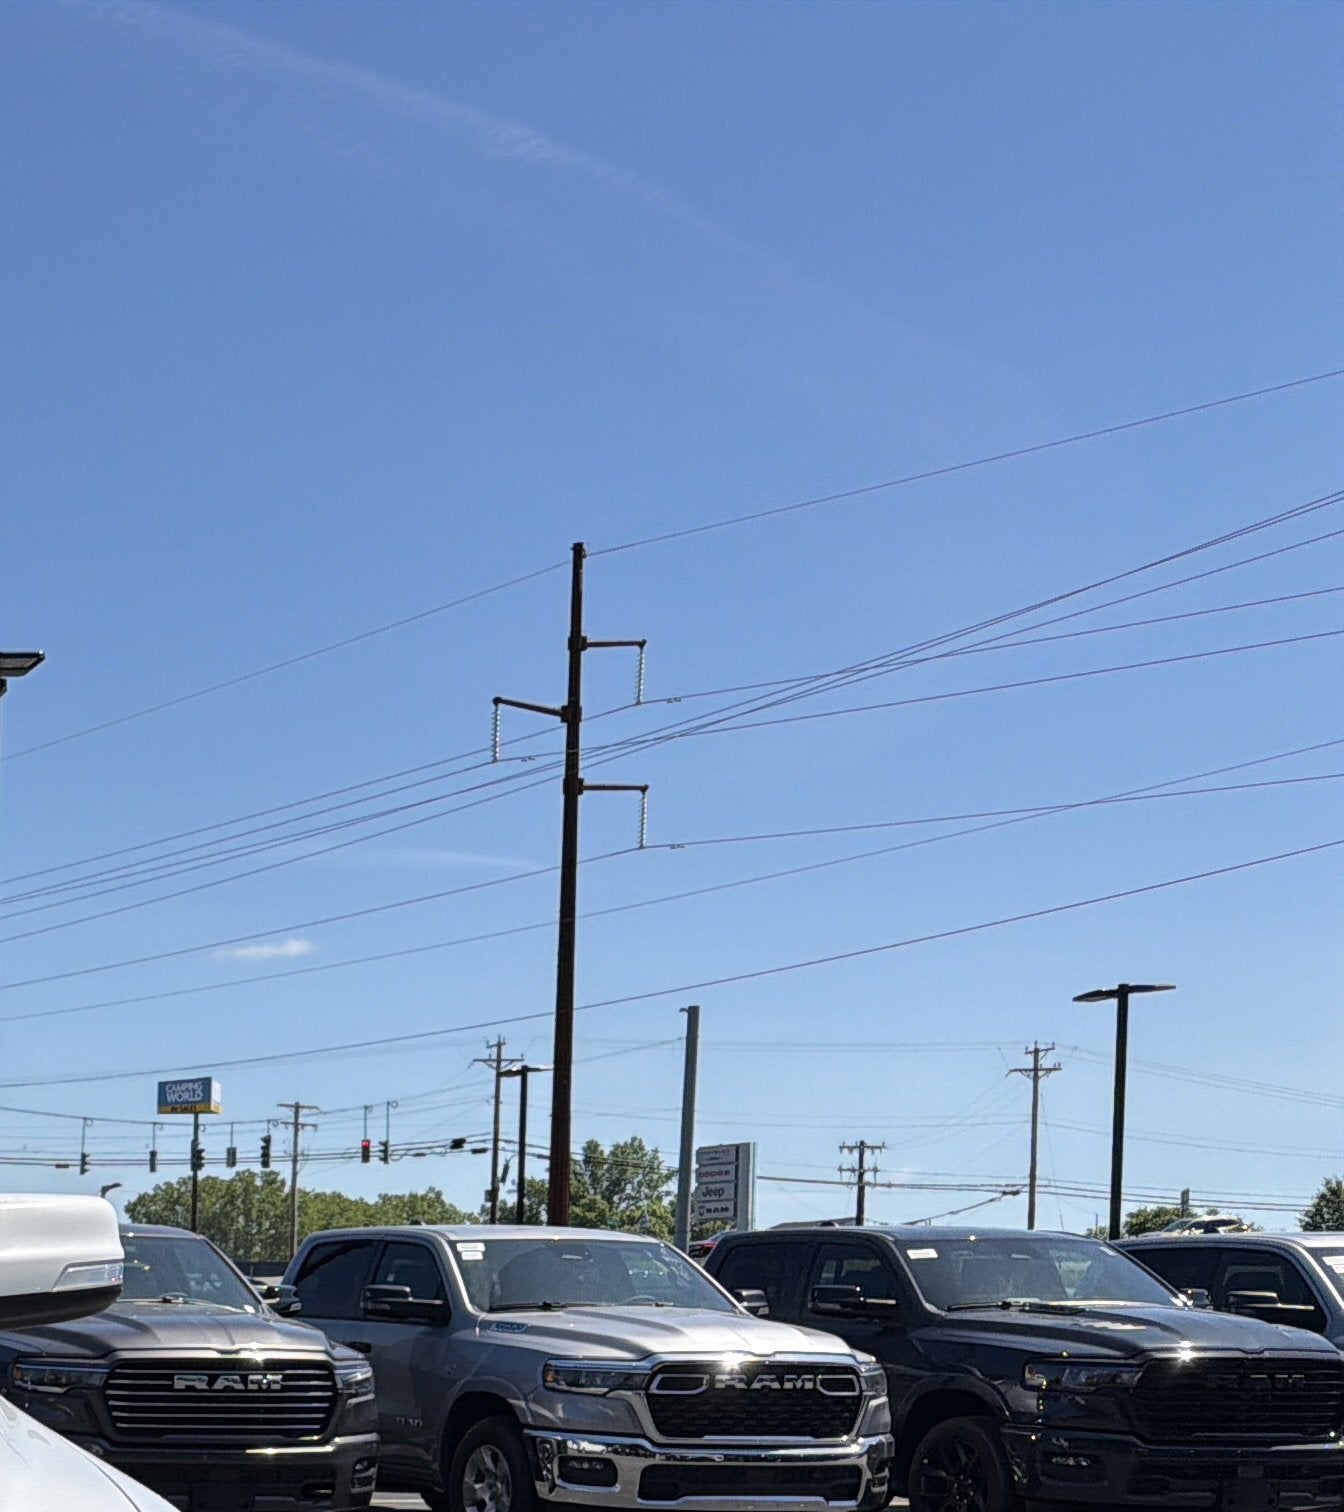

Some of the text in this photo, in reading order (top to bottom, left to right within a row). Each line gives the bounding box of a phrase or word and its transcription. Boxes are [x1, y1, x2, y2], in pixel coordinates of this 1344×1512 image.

[166, 1081, 203, 1092] CAMPING
[166, 1090, 204, 1103] WORLD
[702, 1186, 725, 1198] Jeep
[706, 1206, 729, 1214] RAM
[173, 1374, 283, 1390] RAM
[714, 1374, 815, 1389] RAM
